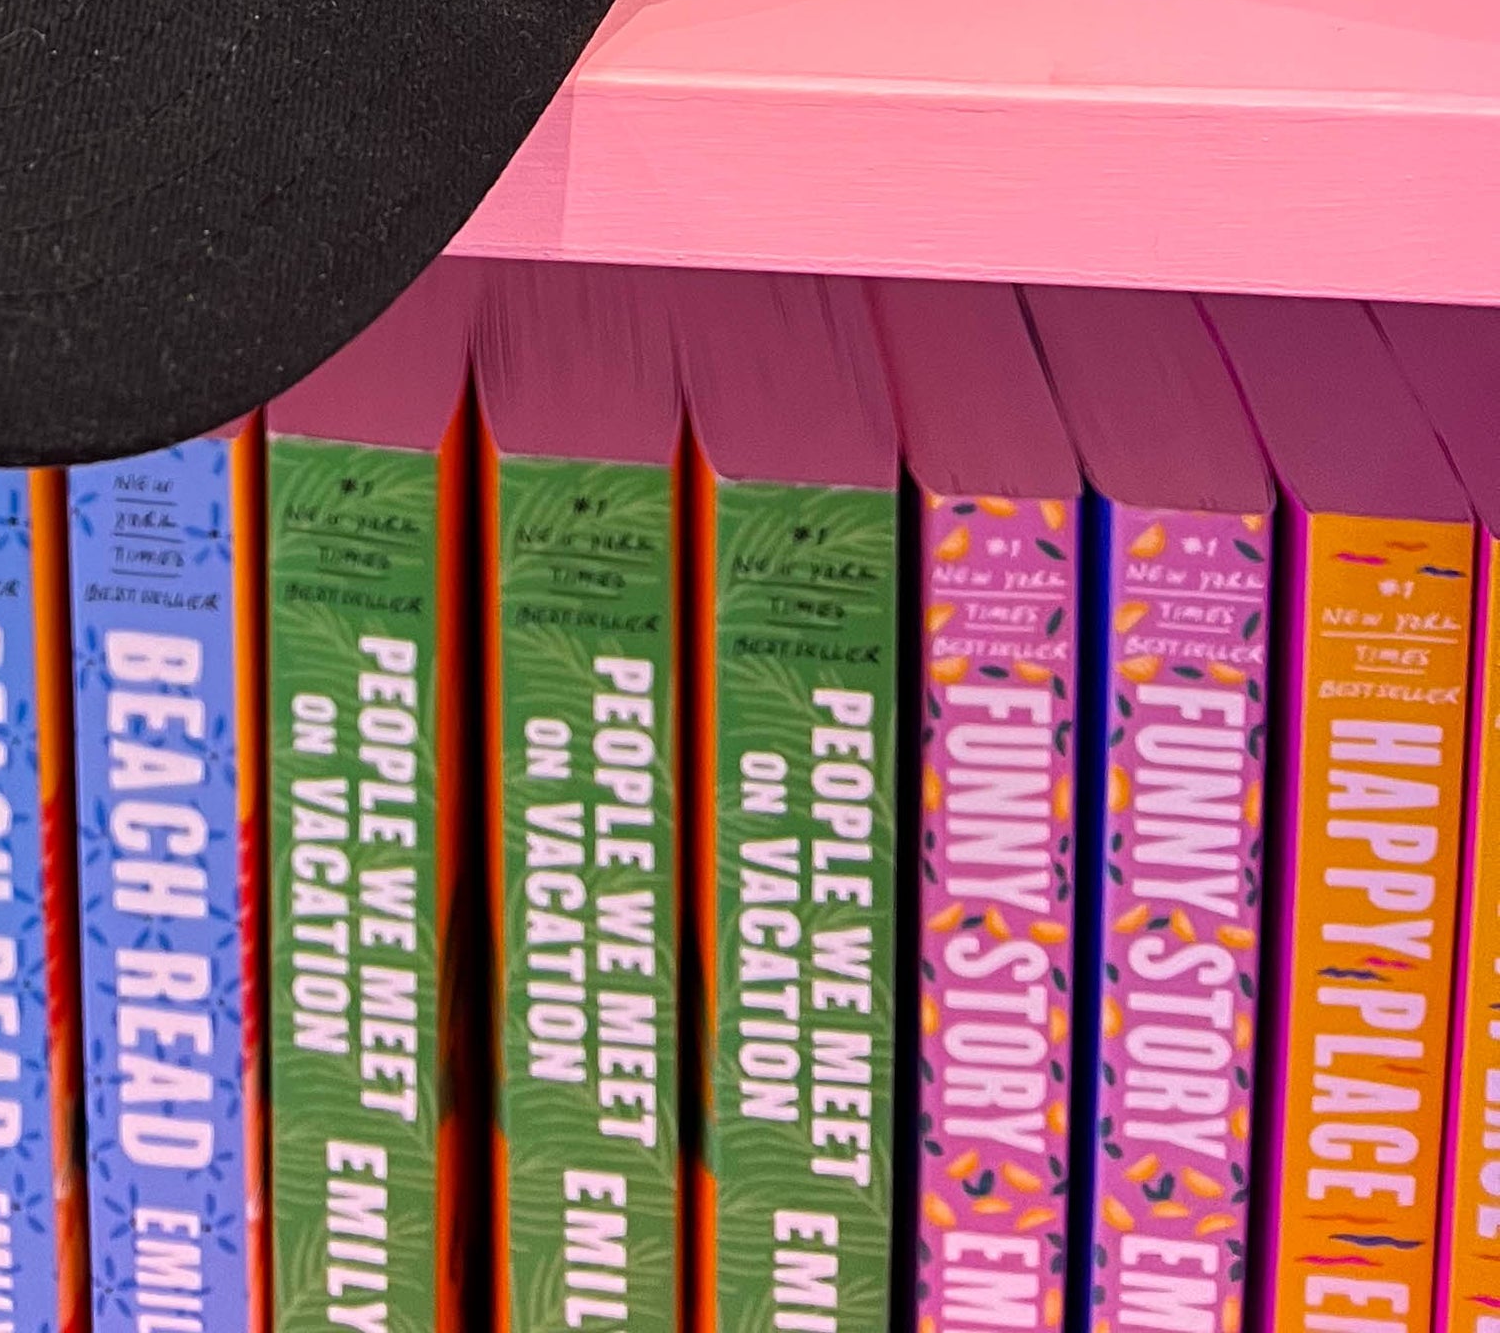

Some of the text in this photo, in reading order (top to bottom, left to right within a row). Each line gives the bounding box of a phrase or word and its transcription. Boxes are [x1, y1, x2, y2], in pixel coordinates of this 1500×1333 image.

[1124, 636, 1264, 665] BESTSELLER
[1318, 680, 1462, 705] BESTSELLER
[104, 627, 215, 1169] BEACH READ
[290, 692, 350, 1055] ON VACATION
[357, 635, 419, 1123] PEOPLE WE MEET
[523, 716, 587, 1083] ON VACATION
[592, 655, 658, 1149] PEOPLE WE MEET
[738, 750, 800, 1123] ON VACATION
[810, 687, 875, 1189] PEOPLE WE MEET
[942, 683, 1053, 1155] FUNNY STORY
[1122, 683, 1247, 1161] FUNNY STORY
[1321, 718, 1444, 961] HAPPY
[326, 1139, 389, 1333] EMILY
[1306, 986, 1428, 1208] PLACE
